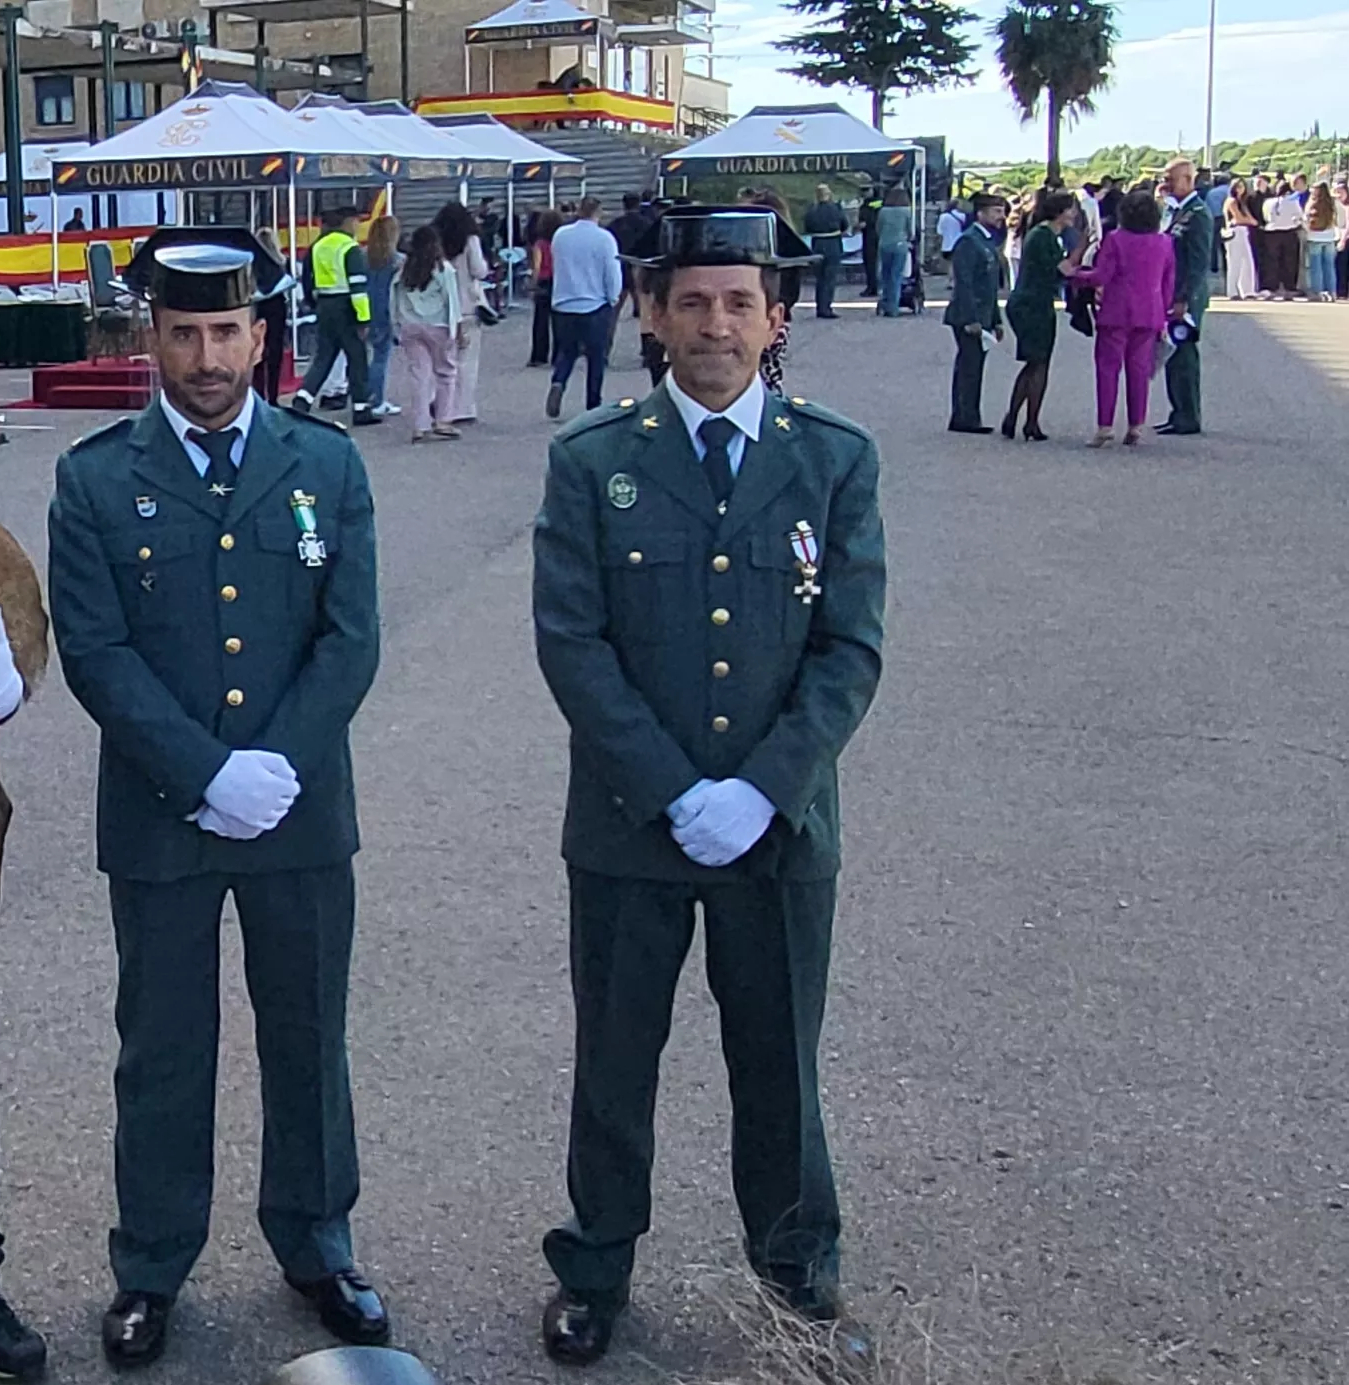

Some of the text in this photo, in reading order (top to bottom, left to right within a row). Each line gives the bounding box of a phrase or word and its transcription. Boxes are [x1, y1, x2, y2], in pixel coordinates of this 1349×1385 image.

[86, 158, 254, 186] GUARDIA CIVIL
[716, 154, 851, 174] GUARDIA CIVIL
